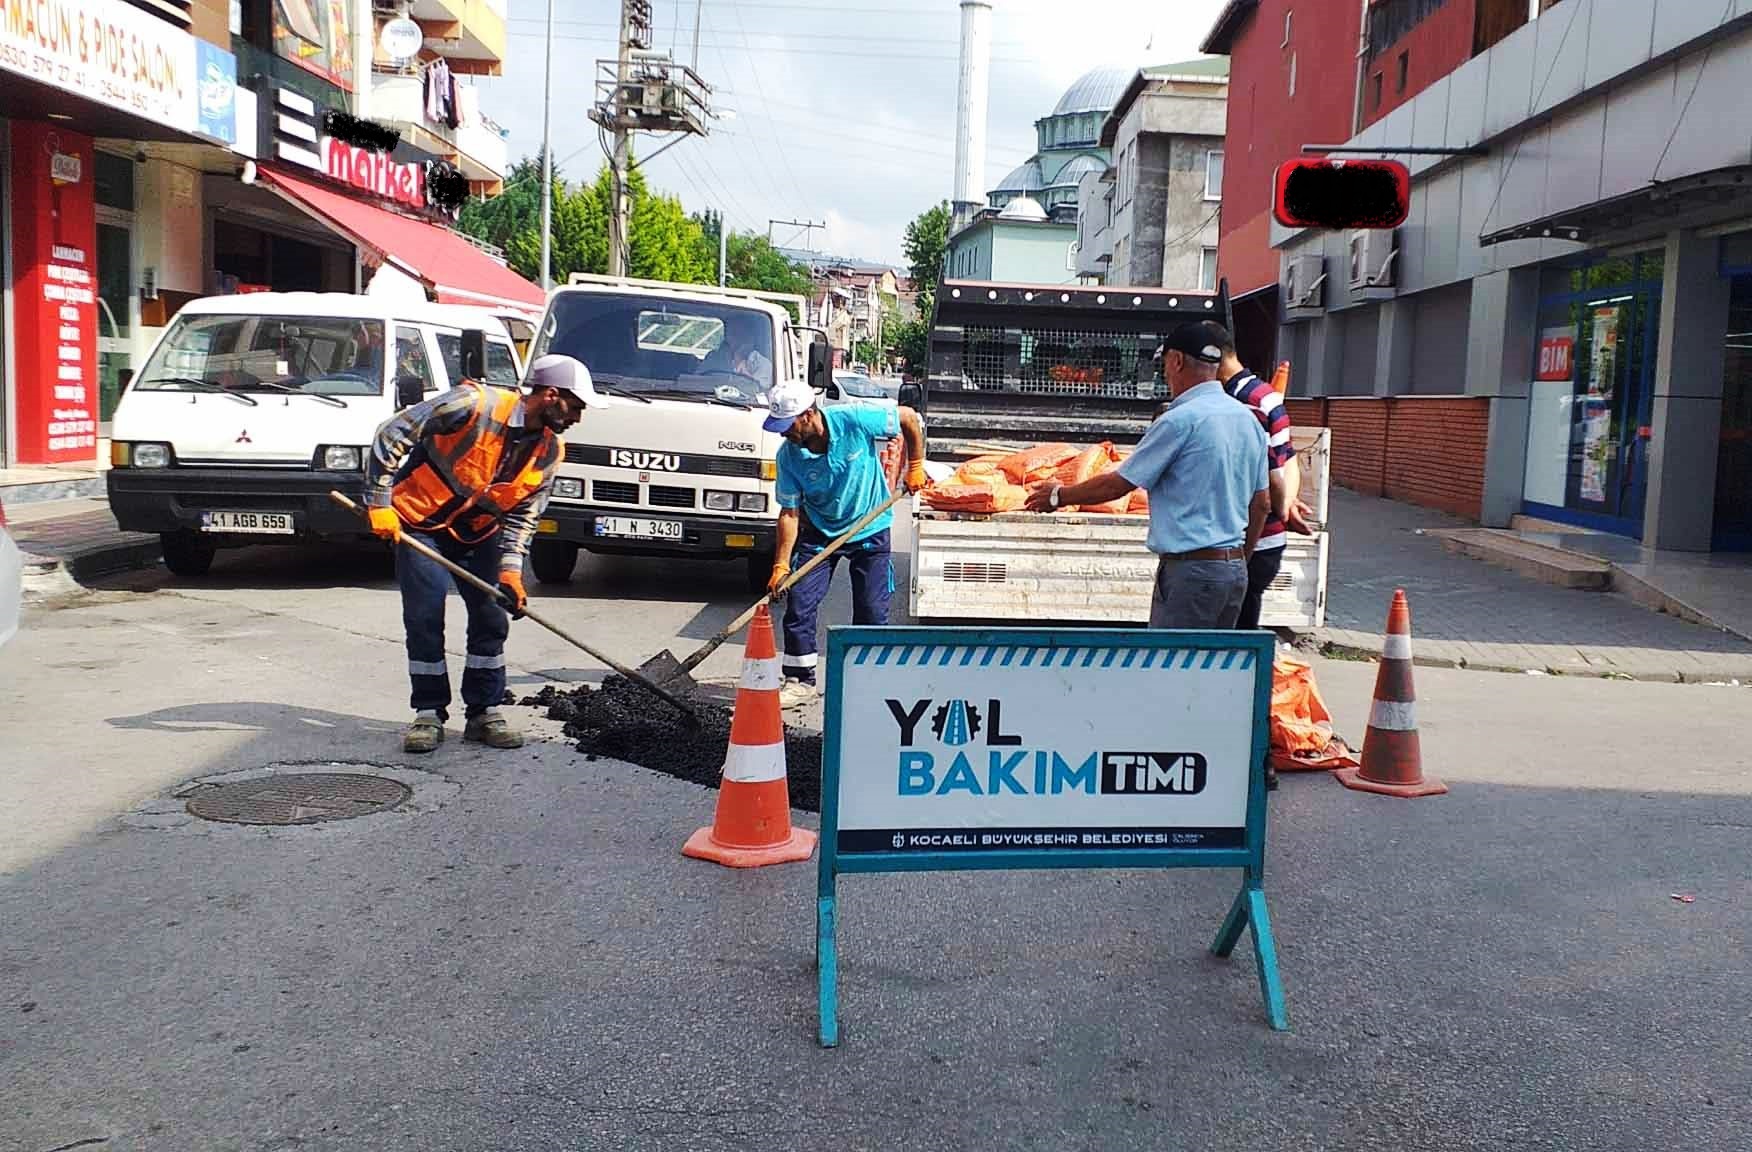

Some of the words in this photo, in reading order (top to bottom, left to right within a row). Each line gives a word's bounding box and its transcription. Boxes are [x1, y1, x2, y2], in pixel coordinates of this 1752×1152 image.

[328, 136, 426, 208] market
[1540, 339, 1568, 374] BİM
[609, 449, 681, 471] ISUZU
[211, 512, 226, 528] 41
[233, 514, 258, 529] AGB
[262, 515, 287, 529] 659
[603, 517, 618, 532] 41
[630, 520, 638, 533] N
[649, 521, 680, 537] 3430
[898, 750, 1099, 796] BAKIM
